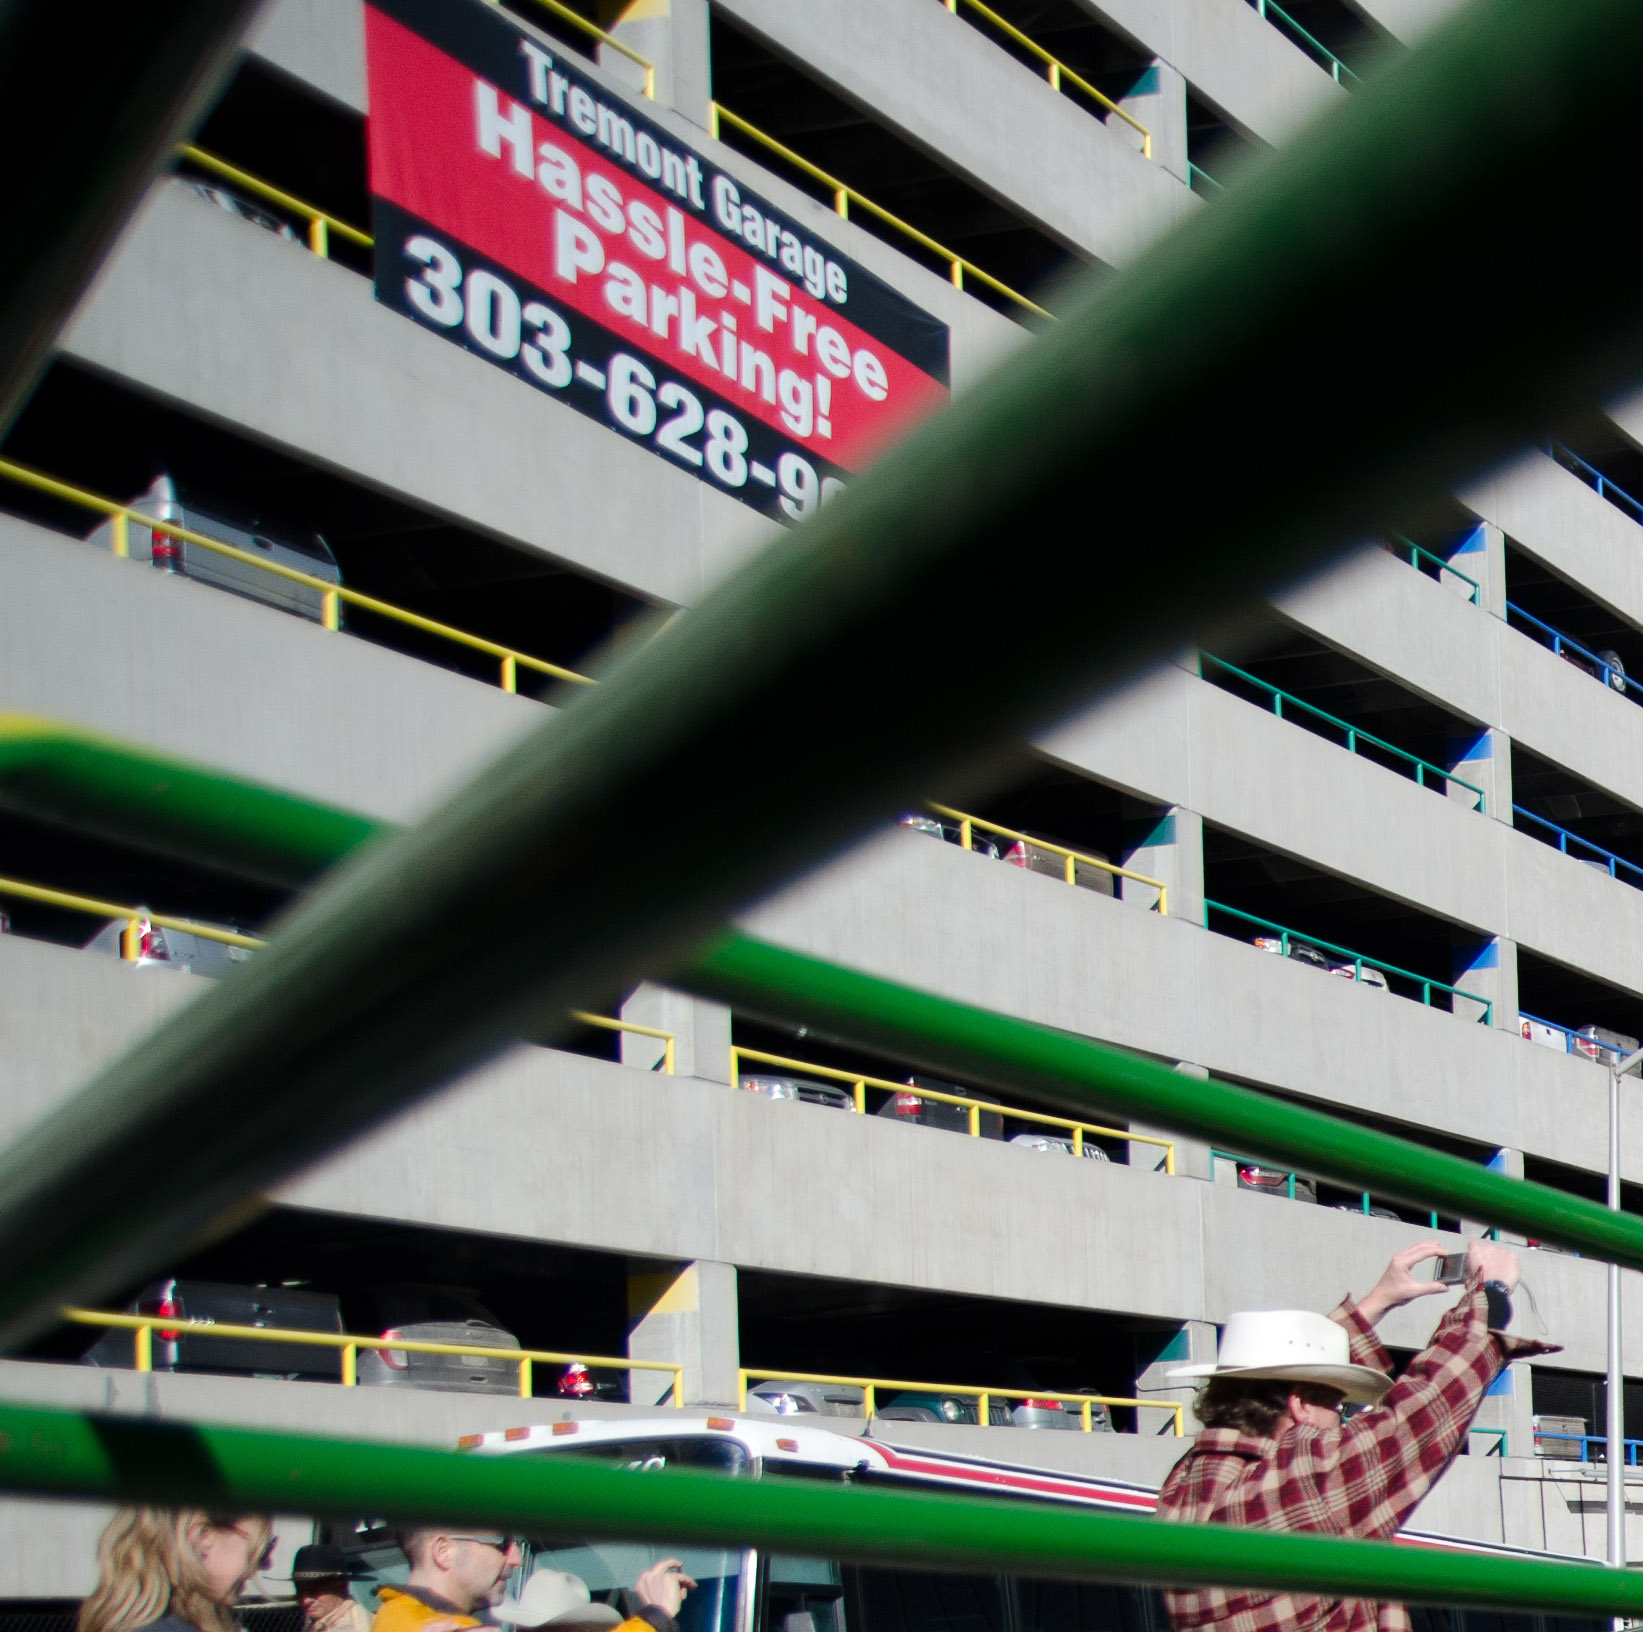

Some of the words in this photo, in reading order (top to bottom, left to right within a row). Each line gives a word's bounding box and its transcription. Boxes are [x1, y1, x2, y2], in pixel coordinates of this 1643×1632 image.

[474, 79, 890, 401] Hassle-Free
[522, 39, 705, 210] Tremont
[713, 173, 849, 304] Garage
[555, 208, 832, 440] Parking!
